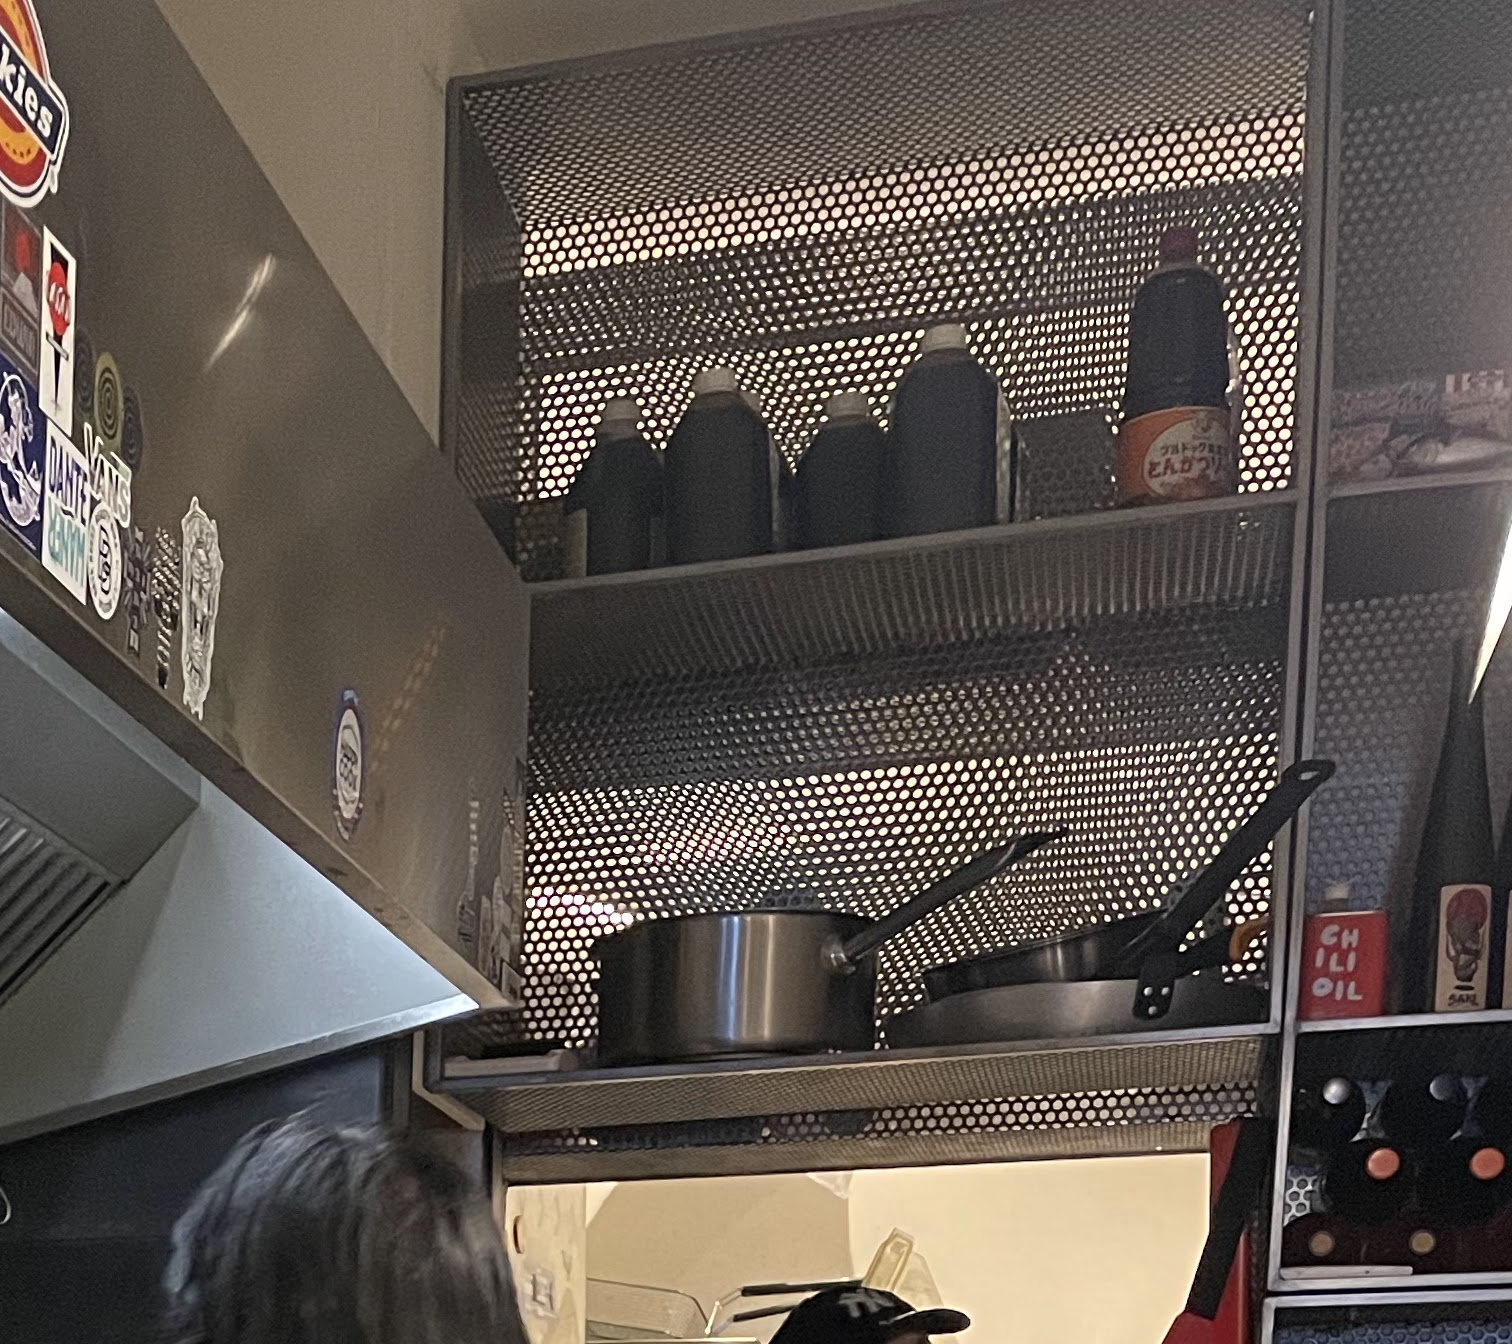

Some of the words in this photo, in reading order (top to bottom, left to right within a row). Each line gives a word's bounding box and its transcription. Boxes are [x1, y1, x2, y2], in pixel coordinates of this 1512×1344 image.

[1320, 924, 1360, 949] CH
[1315, 947, 1357, 973] ILI
[1312, 977, 1363, 1001] OIL
